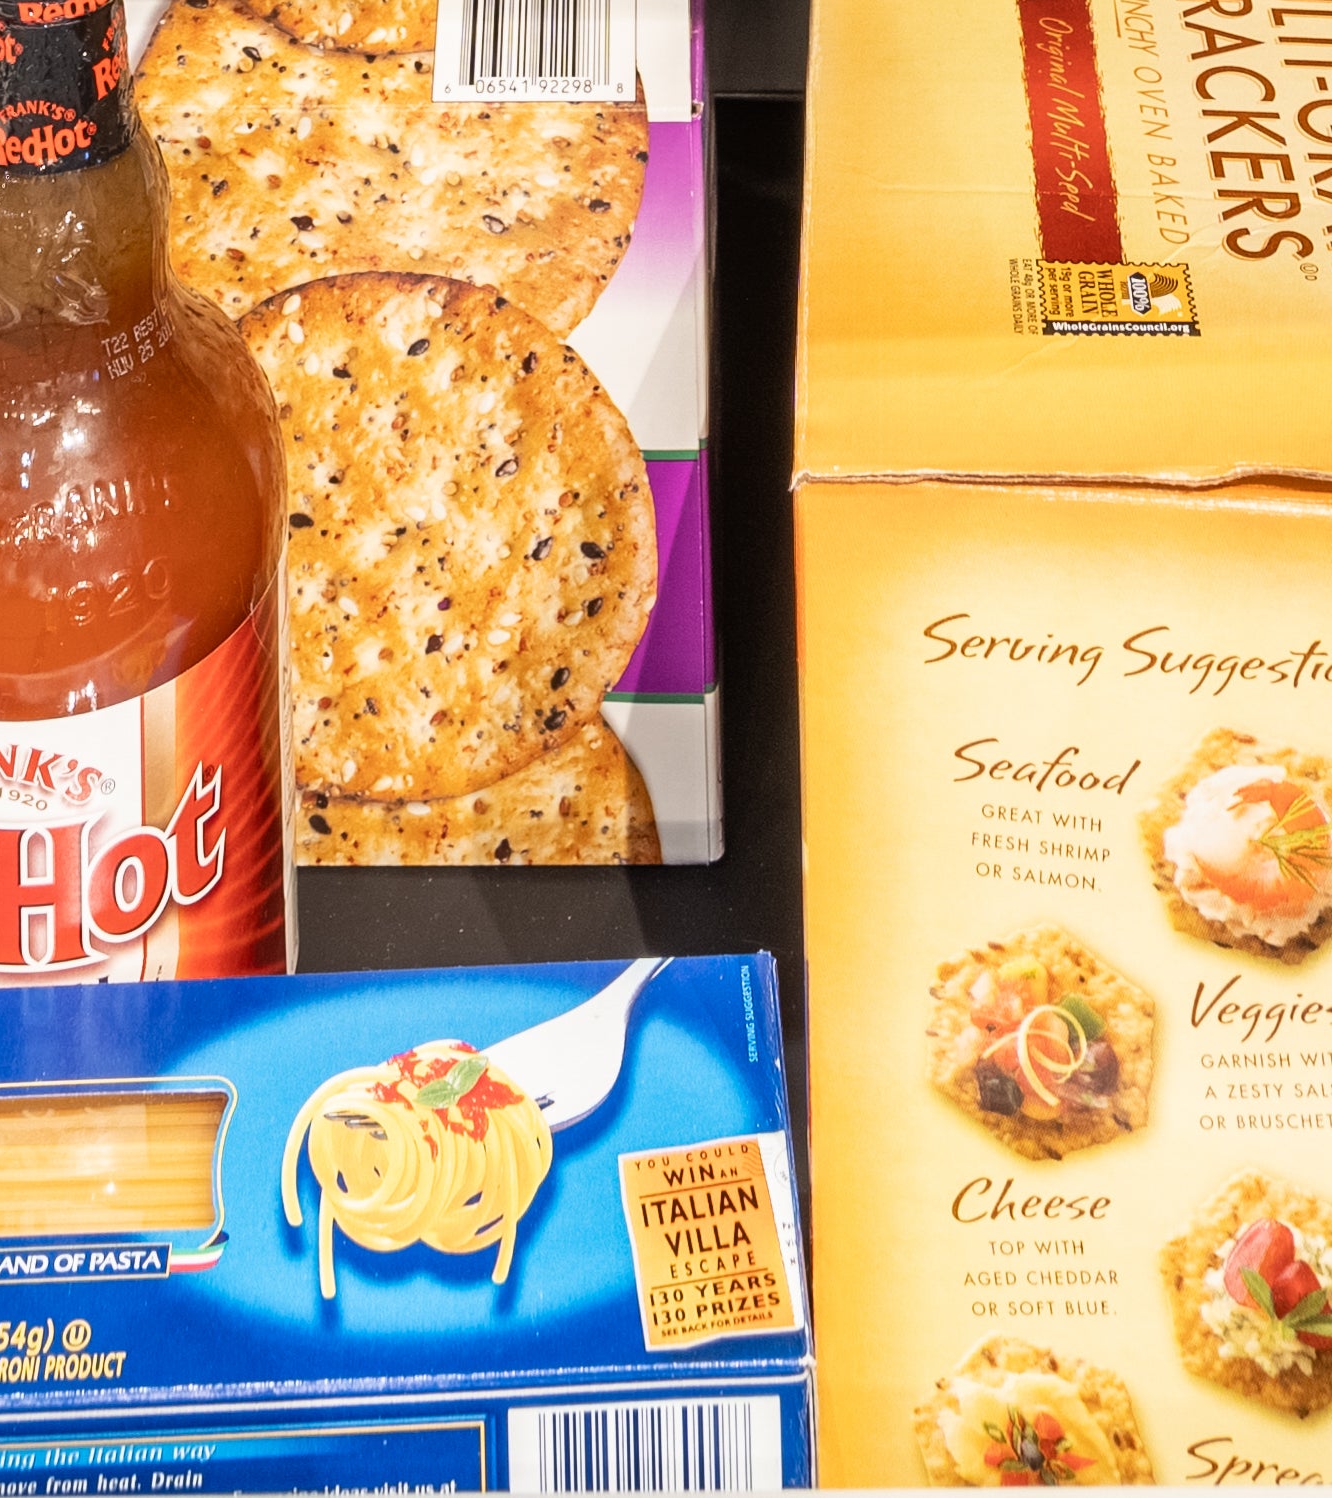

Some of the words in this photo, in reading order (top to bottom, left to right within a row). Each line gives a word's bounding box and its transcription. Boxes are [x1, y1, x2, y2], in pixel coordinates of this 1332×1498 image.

[1037, 16, 1085, 98] Original
[475, 79, 529, 95] 06541
[539, 79, 593, 95] 92298
[1134, 66, 1173, 141] OVEN
[1047, 96, 1096, 222] Multi-Seed
[1147, 153, 1190, 245] BAKED
[1078, 270, 1099, 315] GRAIN
[1096, 269, 1118, 317] WHOLE
[1131, 276, 1150, 312] 100%
[923, 612, 1105, 686] Serving
[953, 737, 1142, 795] Seafood
[981, 804, 1044, 825] GREAT
[1052, 812, 1103, 833] WITH
[971, 832, 1031, 854] FRESH
[1039, 840, 1111, 863] SHRIMP
[975, 862, 1004, 879] OR
[1012, 866, 1103, 892] SALMON.
[1200, 1053, 1292, 1070] GARNISH
[1204, 1083, 1218, 1100] A
[1226, 1083, 1284, 1099] ZESTY
[1199, 1114, 1227, 1130] OR
[635, 1157, 670, 1171] YOU
[686, 1144, 749, 1162] COULD
[663, 1164, 715, 1187] WIN
[720, 1167, 739, 1179] AN
[641, 1185, 758, 1227] ITALIAN
[951, 1176, 1111, 1224] Cheese
[665, 1221, 751, 1257] VILLA
[988, 1239, 1026, 1256] TOP
[1035, 1238, 1085, 1256] WITH
[53, 1253, 86, 1273] OF
[89, 1251, 161, 1272] PASTA
[670, 1250, 756, 1279] ESCAPE
[650, 1289, 683, 1307] 130
[695, 1272, 777, 1298] YEARS
[964, 1270, 1017, 1287] AGED
[1026, 1269, 1119, 1286] CHEDDAR
[653, 1308, 685, 1326] 130
[696, 1291, 780, 1319] PRIZES
[971, 1300, 999, 1318] OR
[1007, 1299, 1055, 1317] SOFT
[1065, 1299, 1118, 1316] BLUE.
[661, 1328, 678, 1338] SEE
[682, 1323, 708, 1333] BACK
[711, 1319, 731, 1329] FOR
[734, 1312, 773, 1325] DETAILS
[44, 1351, 126, 1381] PRODUCT
[44, 1448, 79, 1466] the
[88, 1444, 163, 1464] Italian
[172, 1442, 216, 1462] way
